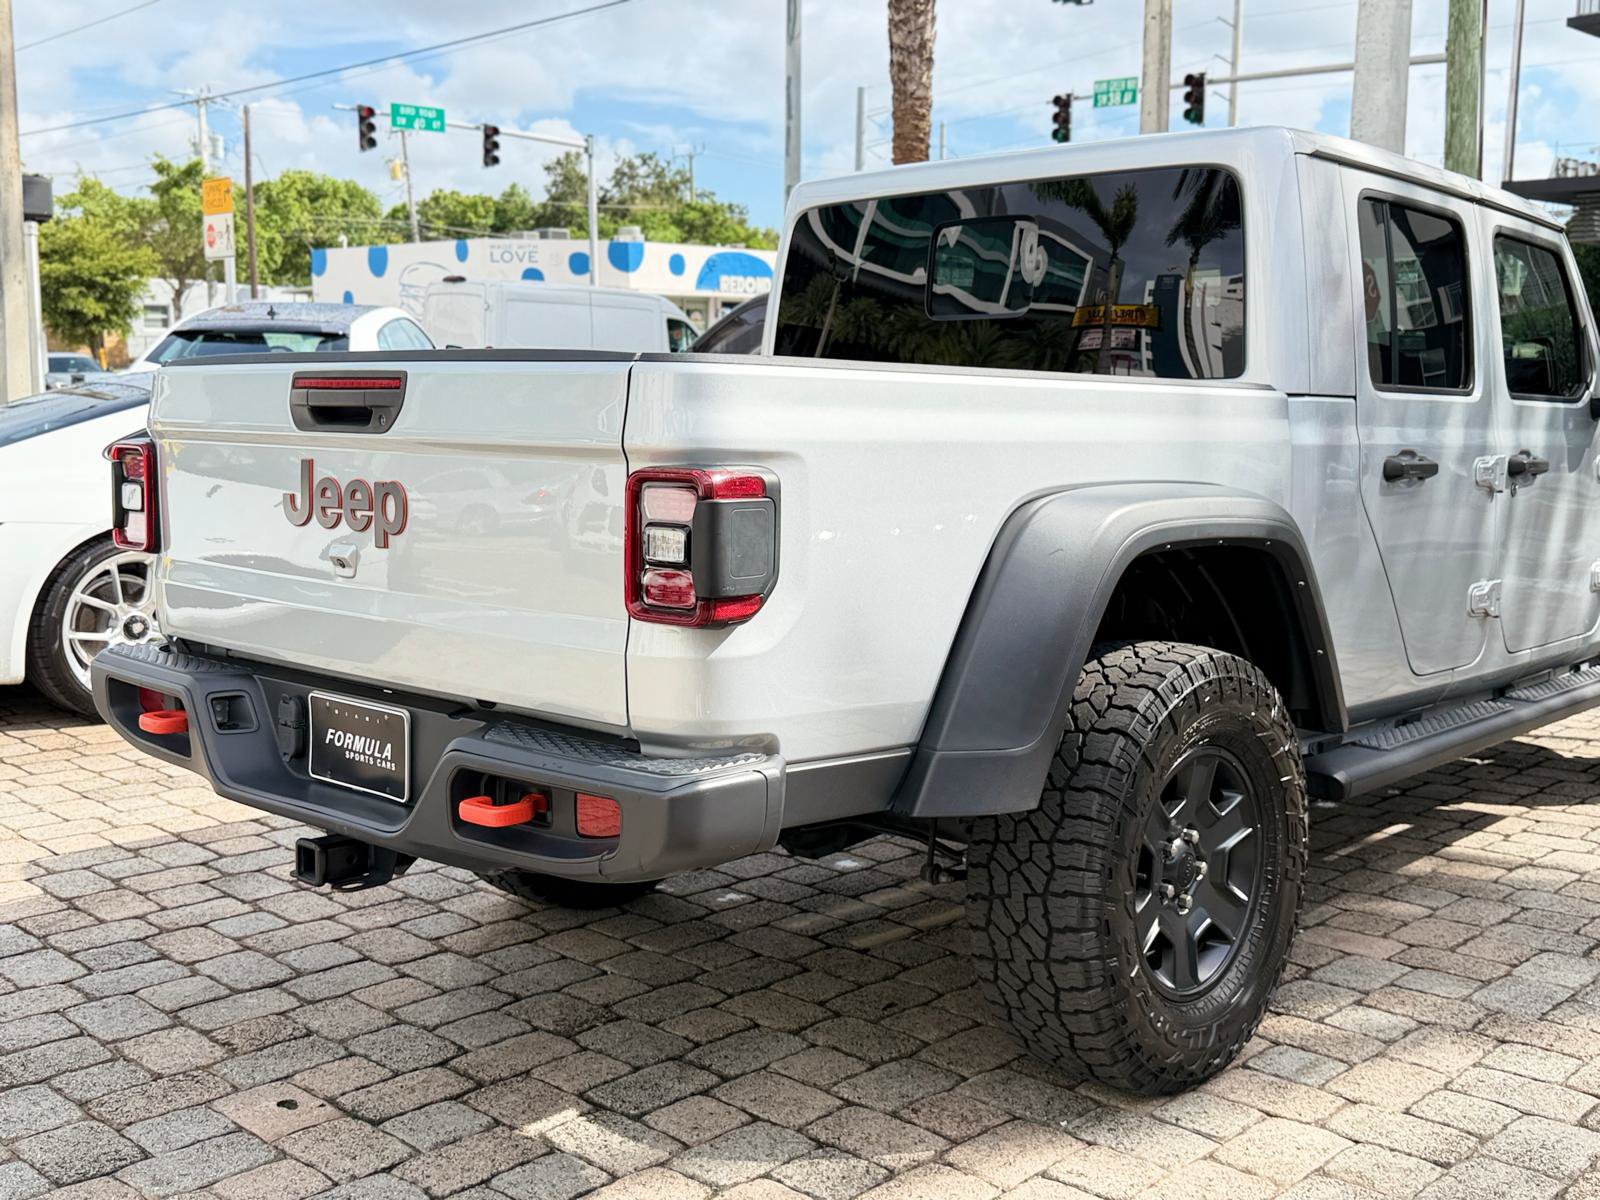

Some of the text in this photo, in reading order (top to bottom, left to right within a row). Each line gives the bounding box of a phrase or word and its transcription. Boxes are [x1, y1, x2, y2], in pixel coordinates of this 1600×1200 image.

[490, 250, 538, 263] LOVE
[283, 458, 408, 549] Jeep
[325, 728, 392, 760] FORMULA
[345, 750, 396, 771] SPORTS CARS
